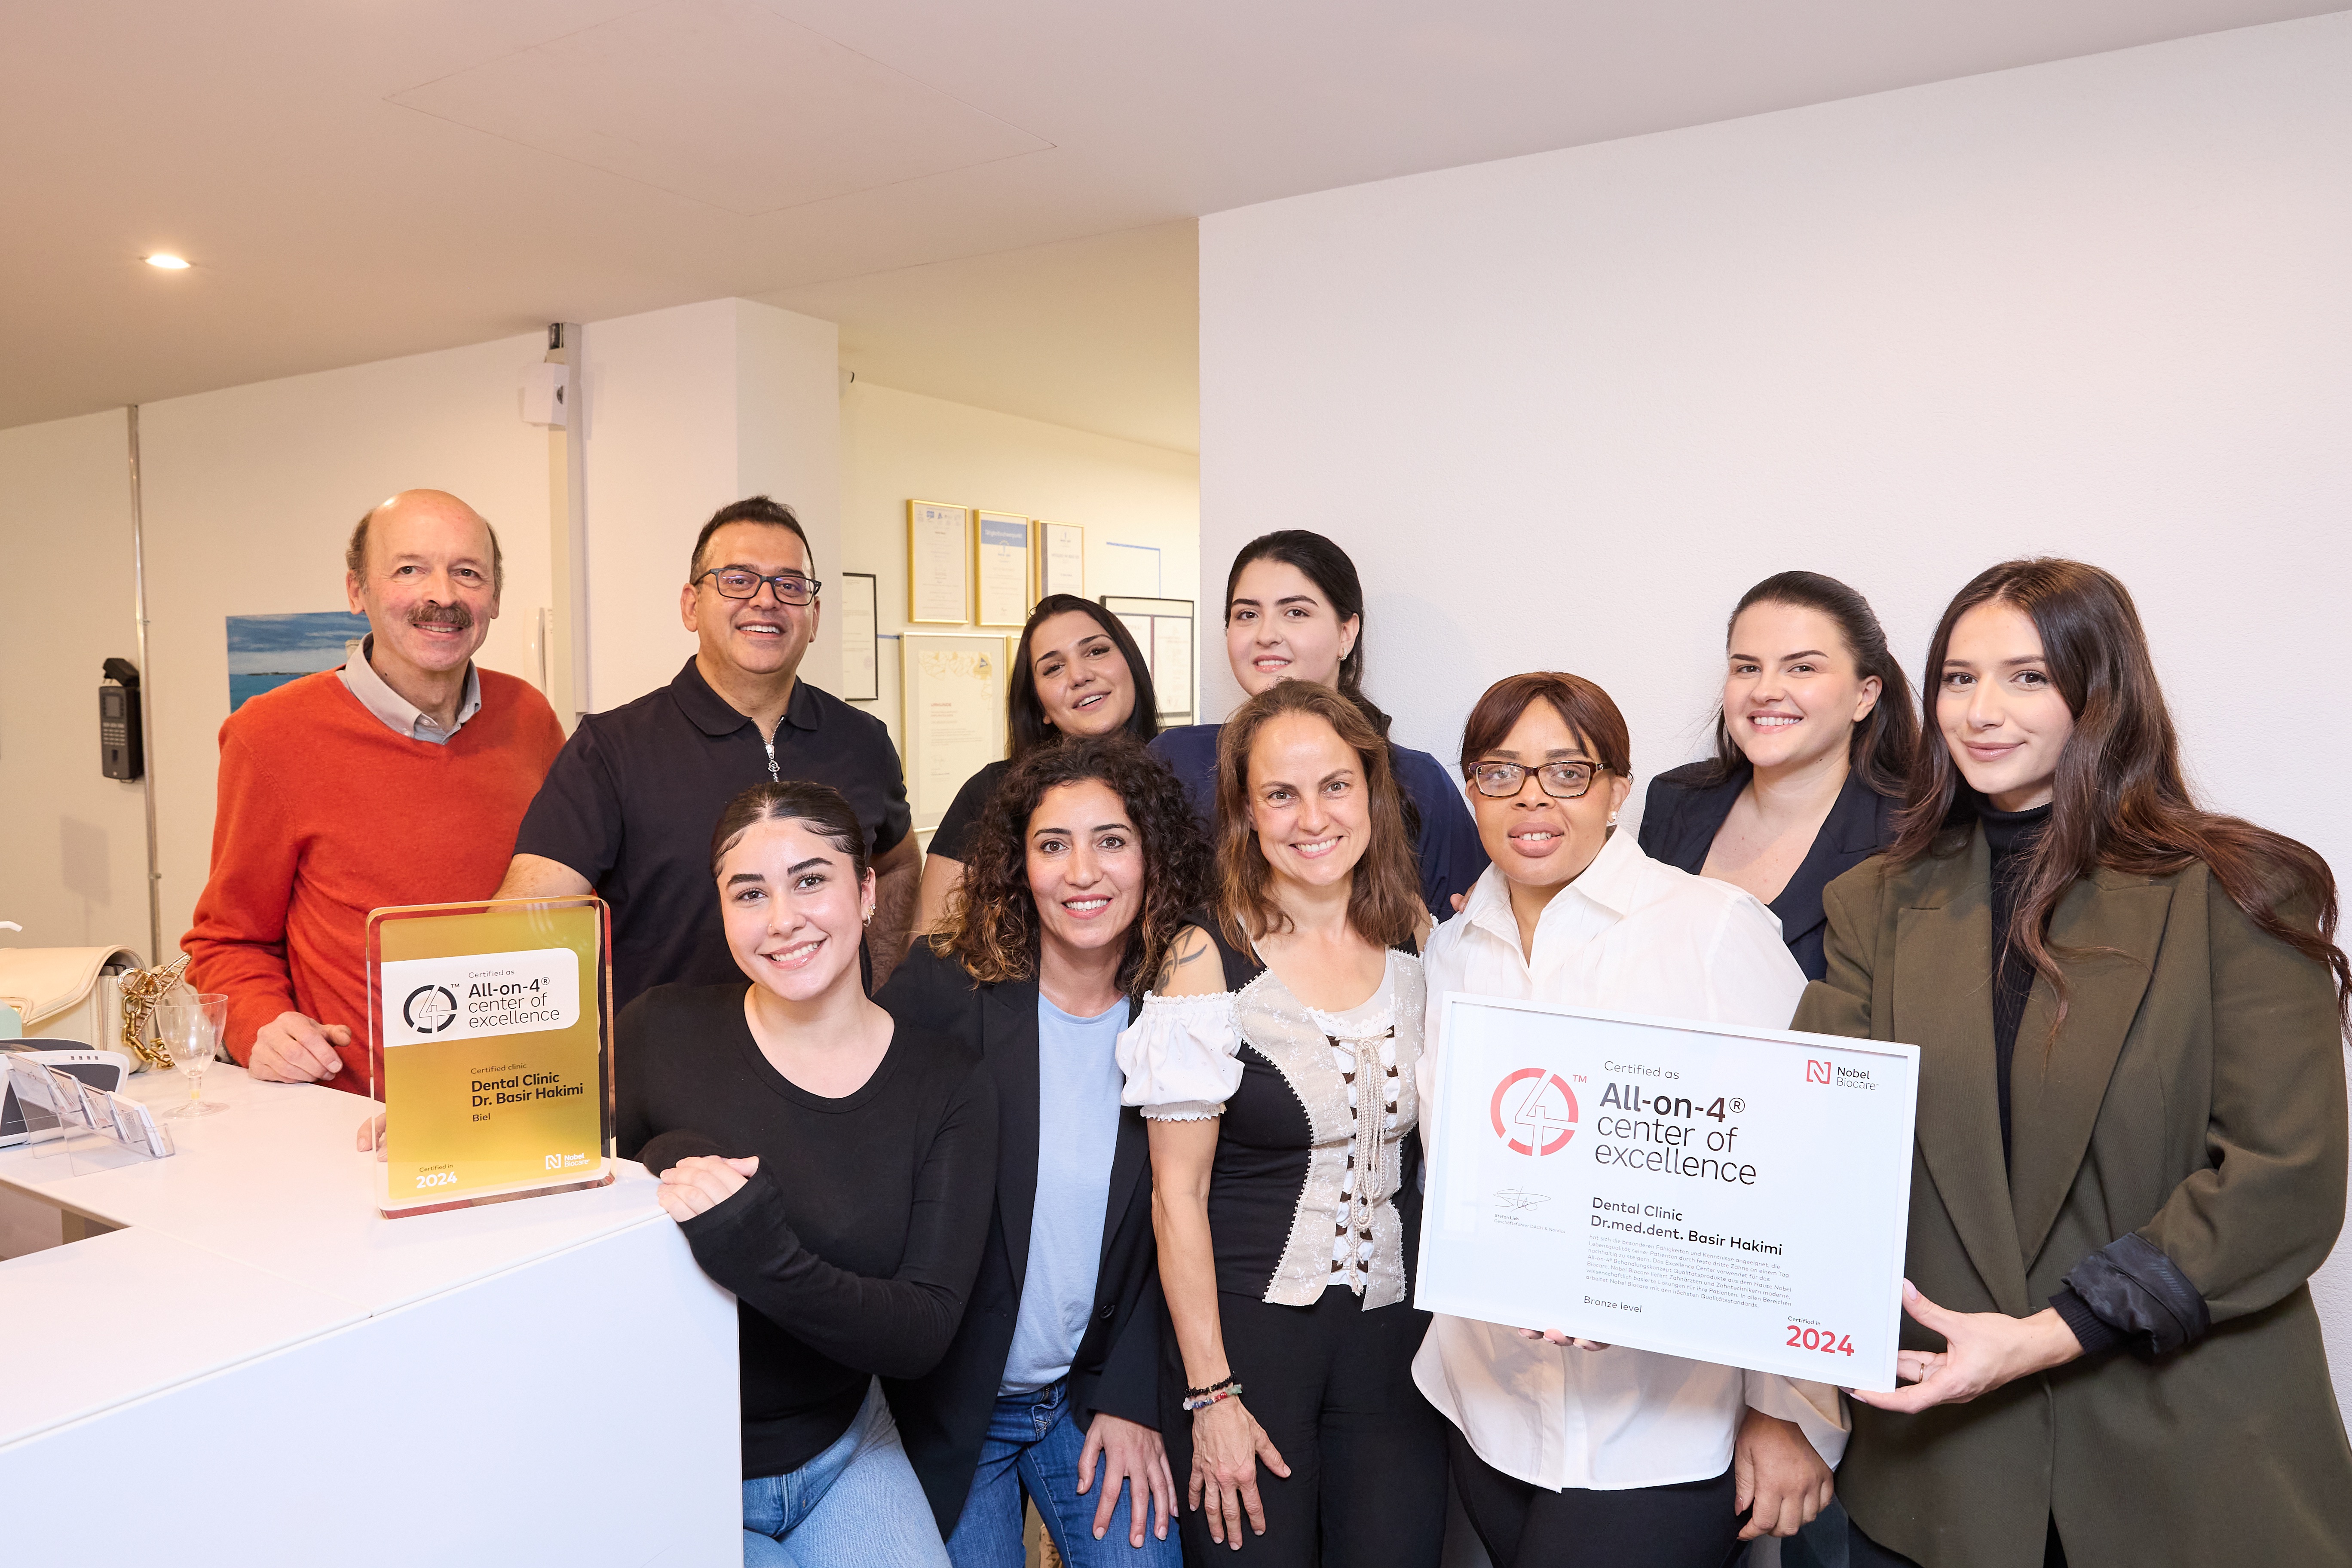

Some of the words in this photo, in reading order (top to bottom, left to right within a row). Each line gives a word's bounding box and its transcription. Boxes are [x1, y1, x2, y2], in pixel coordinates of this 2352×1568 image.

[469, 970, 503, 978] Certified
[469, 997, 524, 1013] center
[531, 992, 548, 1007] of
[469, 1010, 560, 1028] excellence
[471, 1065, 506, 1074] Certified
[1604, 1061, 1661, 1077] Certified
[1665, 1071, 1679, 1079] as
[1838, 1067, 1870, 1079] Nobel
[472, 1075, 519, 1092] Dental
[523, 1072, 560, 1086] Clinic
[472, 1095, 492, 1107] Dr.
[496, 1090, 532, 1104] Basir
[536, 1083, 583, 1099] Hakimi
[473, 1113, 490, 1122] Biel
[1597, 1116, 1695, 1146] center
[1707, 1127, 1738, 1152] of
[564, 1152, 585, 1161] Nobel
[1595, 1144, 1756, 1185] excellence
[420, 1164, 446, 1172] Certified
[416, 1171, 458, 1188] 2024
[1592, 1197, 1640, 1215] Dental
[1644, 1205, 1683, 1221] Clinic
[1591, 1215, 1683, 1240] Dr.med.dent.
[1688, 1230, 1726, 1246] Basir
[1730, 1237, 1782, 1255] Hakimi
[1588, 1249, 1617, 1258] nachhaltig
[1665, 1260, 1694, 1269] Excellence
[1717, 1270, 1748, 1278] verwendet
[1589, 1241, 1625, 1252] Lebensqualität
[1650, 1250, 1678, 1259] Patienten
[1731, 1263, 1749, 1271] Zähne
[1622, 1239, 1654, 1249] besonderen
[1656, 1244, 1689, 1255] Fähigkeiten
[1703, 1252, 1734, 1262] Kenntnisse
[1736, 1259, 1770, 1268] angeeignet,
[1614, 1257, 1672, 1273] Behandlungskonzept
[1673, 1268, 1726, 1281] Qualitätsprodukte
[1586, 1268, 1632, 1280] wissenschaftlich
[1633, 1275, 1657, 1284] basierte
[1658, 1279, 1685, 1289] Lösungen
[1709, 1288, 1739, 1298] Patienten.
[1763, 1297, 1792, 1306] Bereichen
[1587, 1261, 1609, 1269] Biocare.
[1629, 1268, 1649, 1276] Biocare
[1669, 1274, 1702, 1285] Zahnärzten
[1716, 1282, 1761, 1294] Zahntechnikern
[1763, 1291, 1791, 1300] moderne,
[1584, 1296, 1617, 1309] Bronze
[1620, 1302, 1642, 1313] level
[1627, 1281, 1648, 1289] Biocare
[1673, 1288, 1699, 1298] höchsten
[1700, 1293, 1759, 1308] Qualitätsstandards.
[1788, 1316, 1814, 1325] Certified
[1786, 1325, 1854, 1357] 2024
